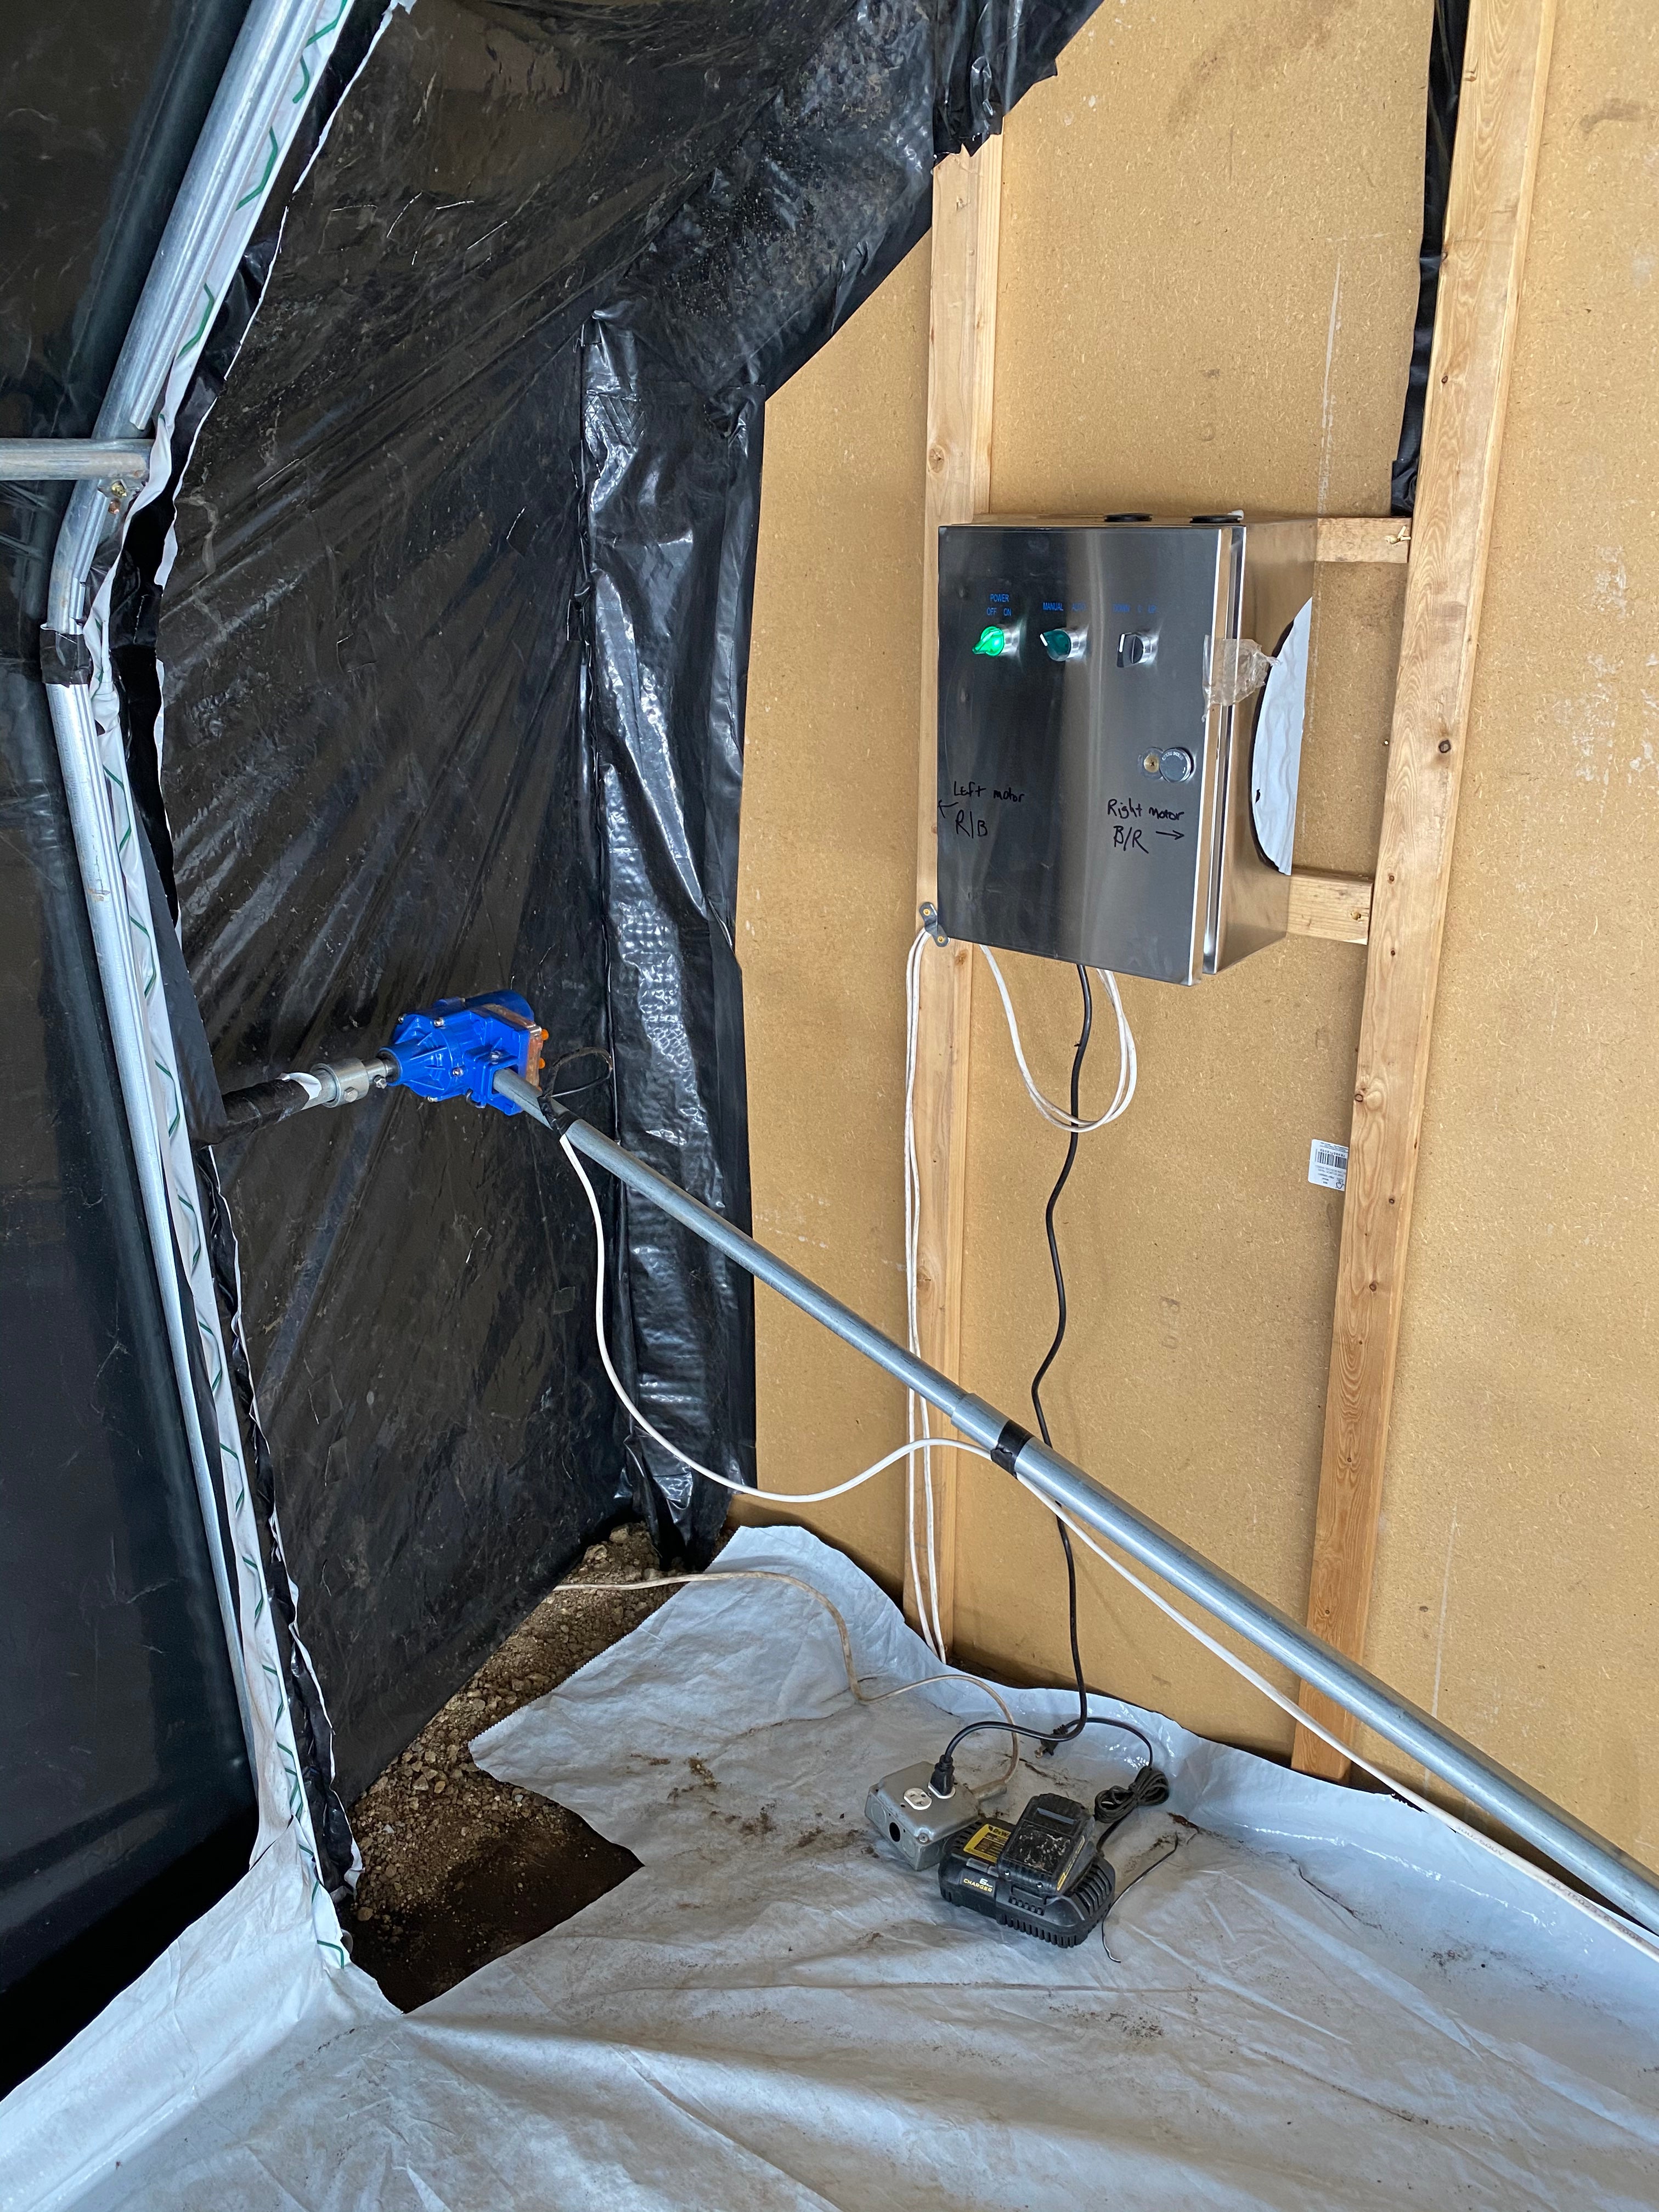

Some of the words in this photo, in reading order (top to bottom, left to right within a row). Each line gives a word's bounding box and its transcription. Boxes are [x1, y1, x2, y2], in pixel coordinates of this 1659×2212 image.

[990, 594, 1009, 602] POWER
[986, 607, 997, 616] OFF
[1003, 607, 1012, 616] ON
[1043, 602, 1064, 611] MANUAL
[993, 787, 1025, 803] motor
[1107, 797, 1143, 819] Right
[1113, 825, 1149, 854] B/R
[963, 1878, 993, 1893] CHARGER
